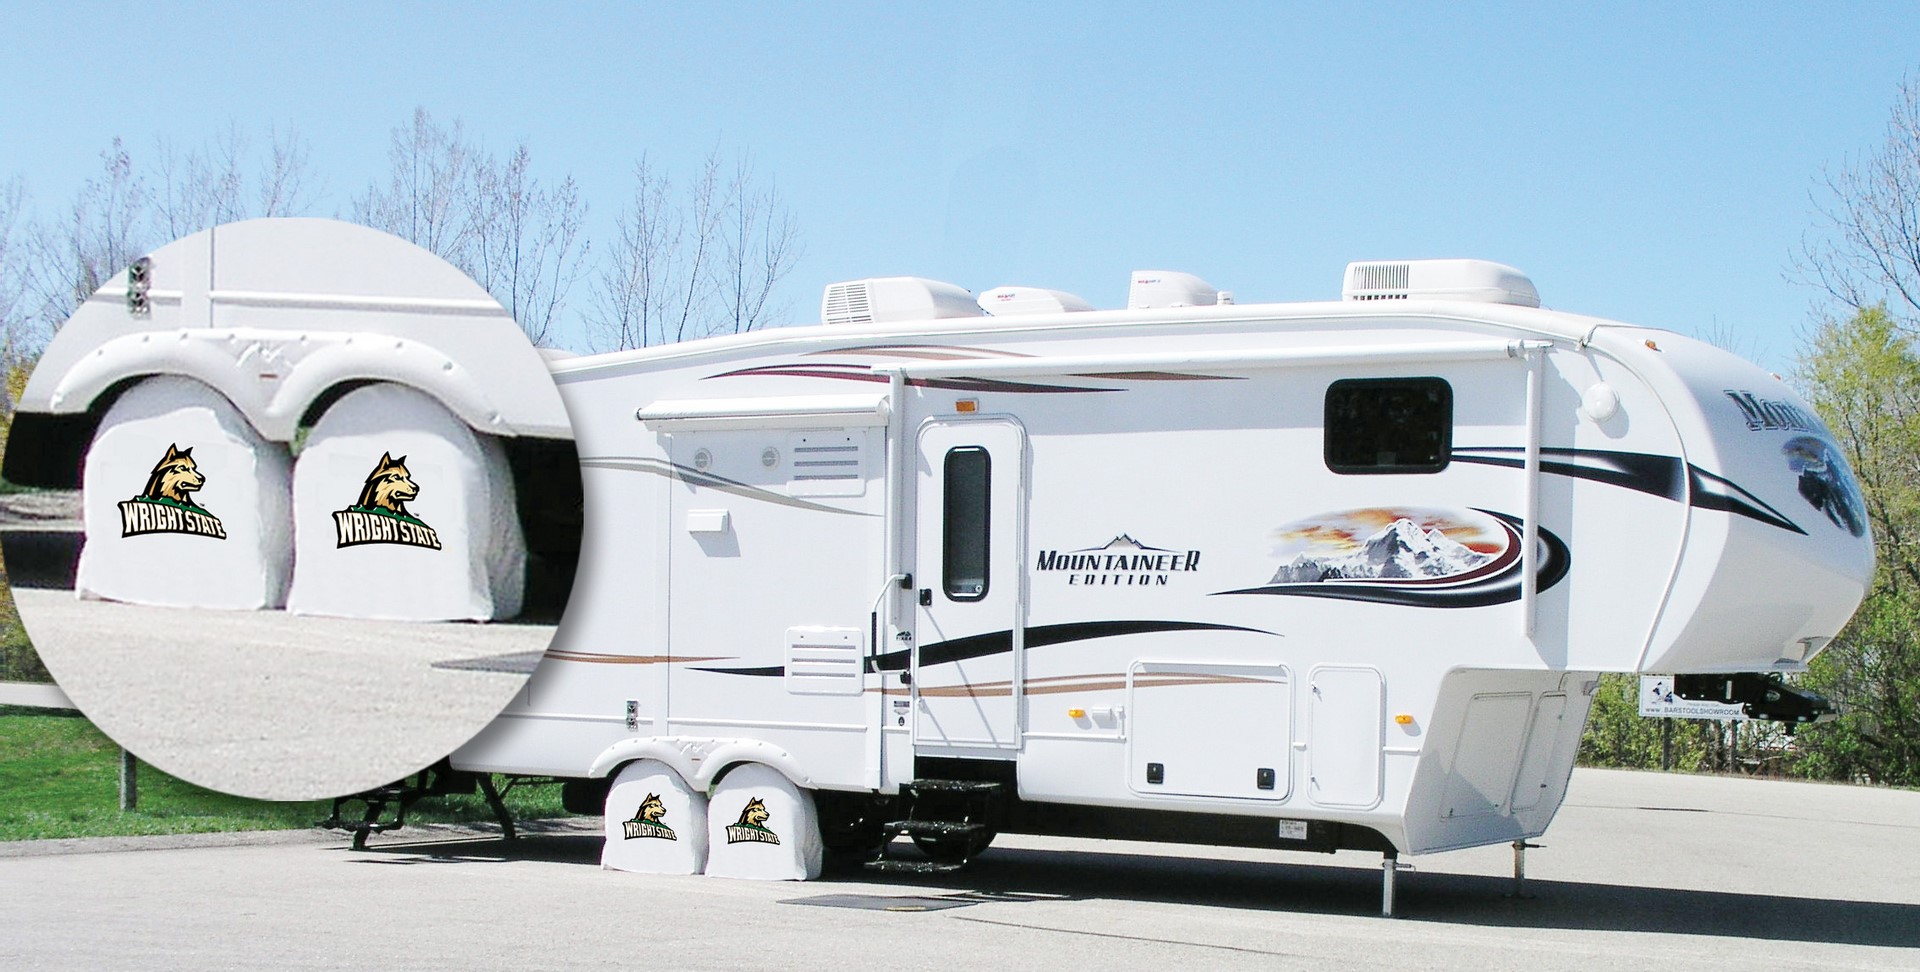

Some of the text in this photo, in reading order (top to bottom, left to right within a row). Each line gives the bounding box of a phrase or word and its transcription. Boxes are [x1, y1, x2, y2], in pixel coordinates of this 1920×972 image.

[121, 502, 226, 538] WRIGHT STATE
[336, 512, 441, 548] WRIGHT STATE
[1036, 549, 1200, 572] MOUNTAINEER
[1068, 573, 1168, 586] EDITION
[624, 822, 677, 840] WRIGHT STATE
[727, 826, 780, 844] WRIGHT STATE
